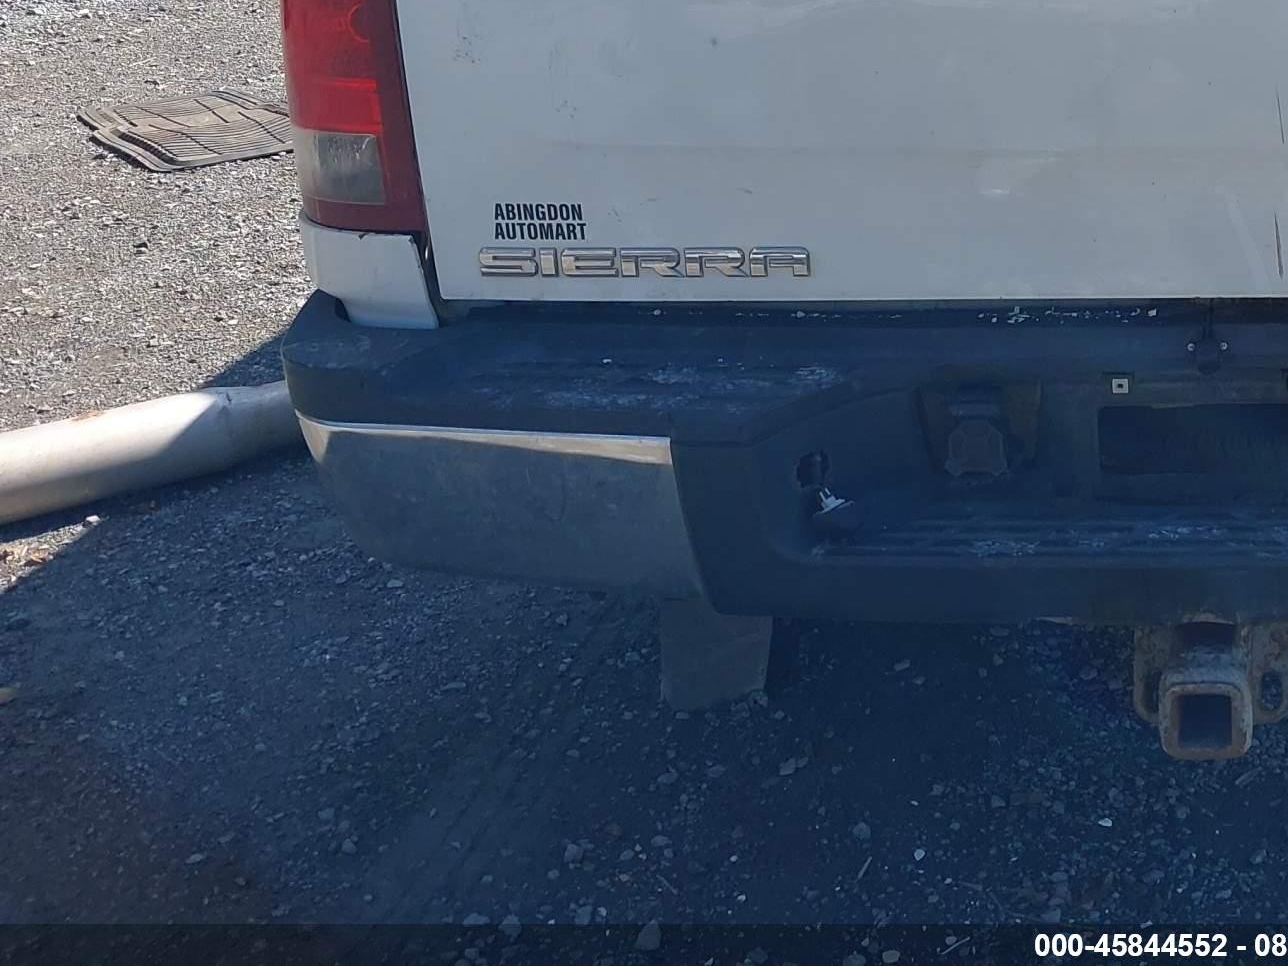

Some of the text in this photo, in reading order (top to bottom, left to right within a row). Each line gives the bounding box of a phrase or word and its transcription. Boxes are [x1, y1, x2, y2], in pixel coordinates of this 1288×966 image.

[494, 203, 583, 221] ABINGDON
[495, 222, 587, 241] AUTOMART
[479, 246, 811, 278] SIERRA
